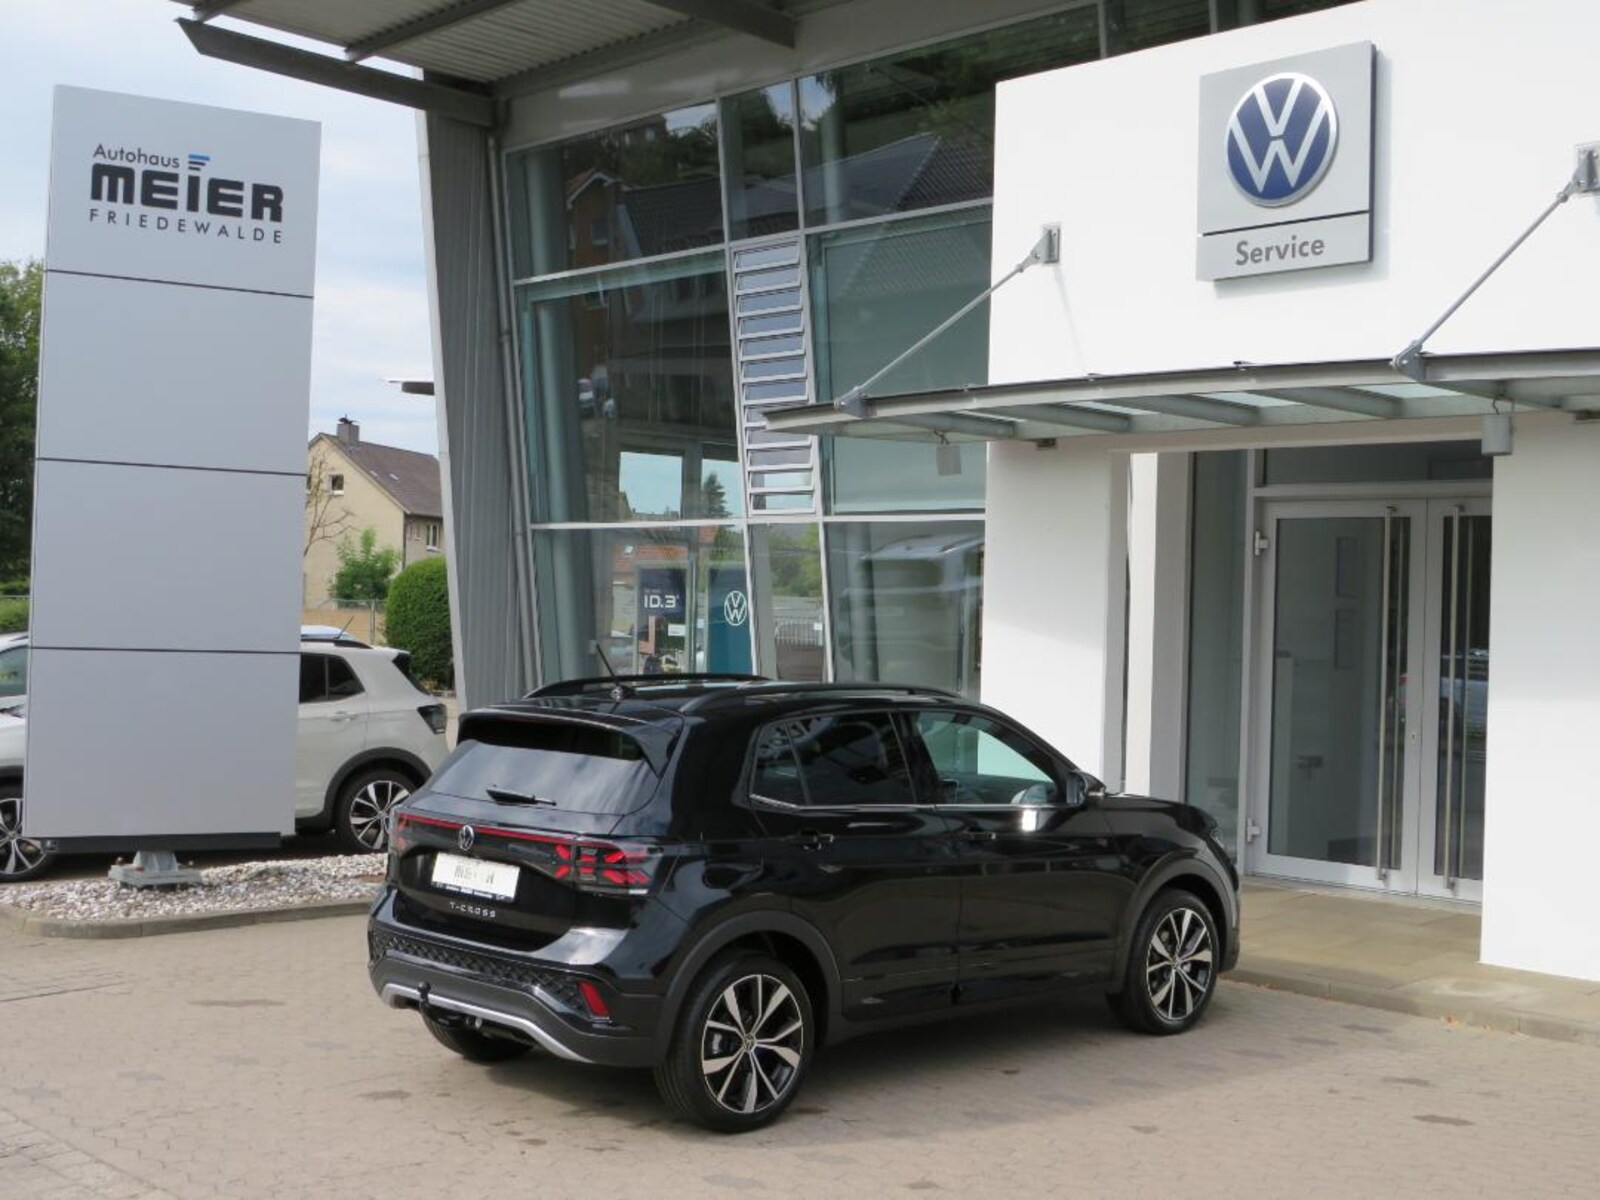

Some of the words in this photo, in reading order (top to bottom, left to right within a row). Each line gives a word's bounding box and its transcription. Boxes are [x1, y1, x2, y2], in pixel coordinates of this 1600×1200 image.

[93, 143, 180, 169] Autohaus
[1225, 73, 1337, 207] VW
[91, 155, 283, 222] MEIER
[90, 208, 282, 244] FRIEDEWALDE
[1235, 235, 1325, 266] Service
[449, 901, 496, 918] T-CROSS
